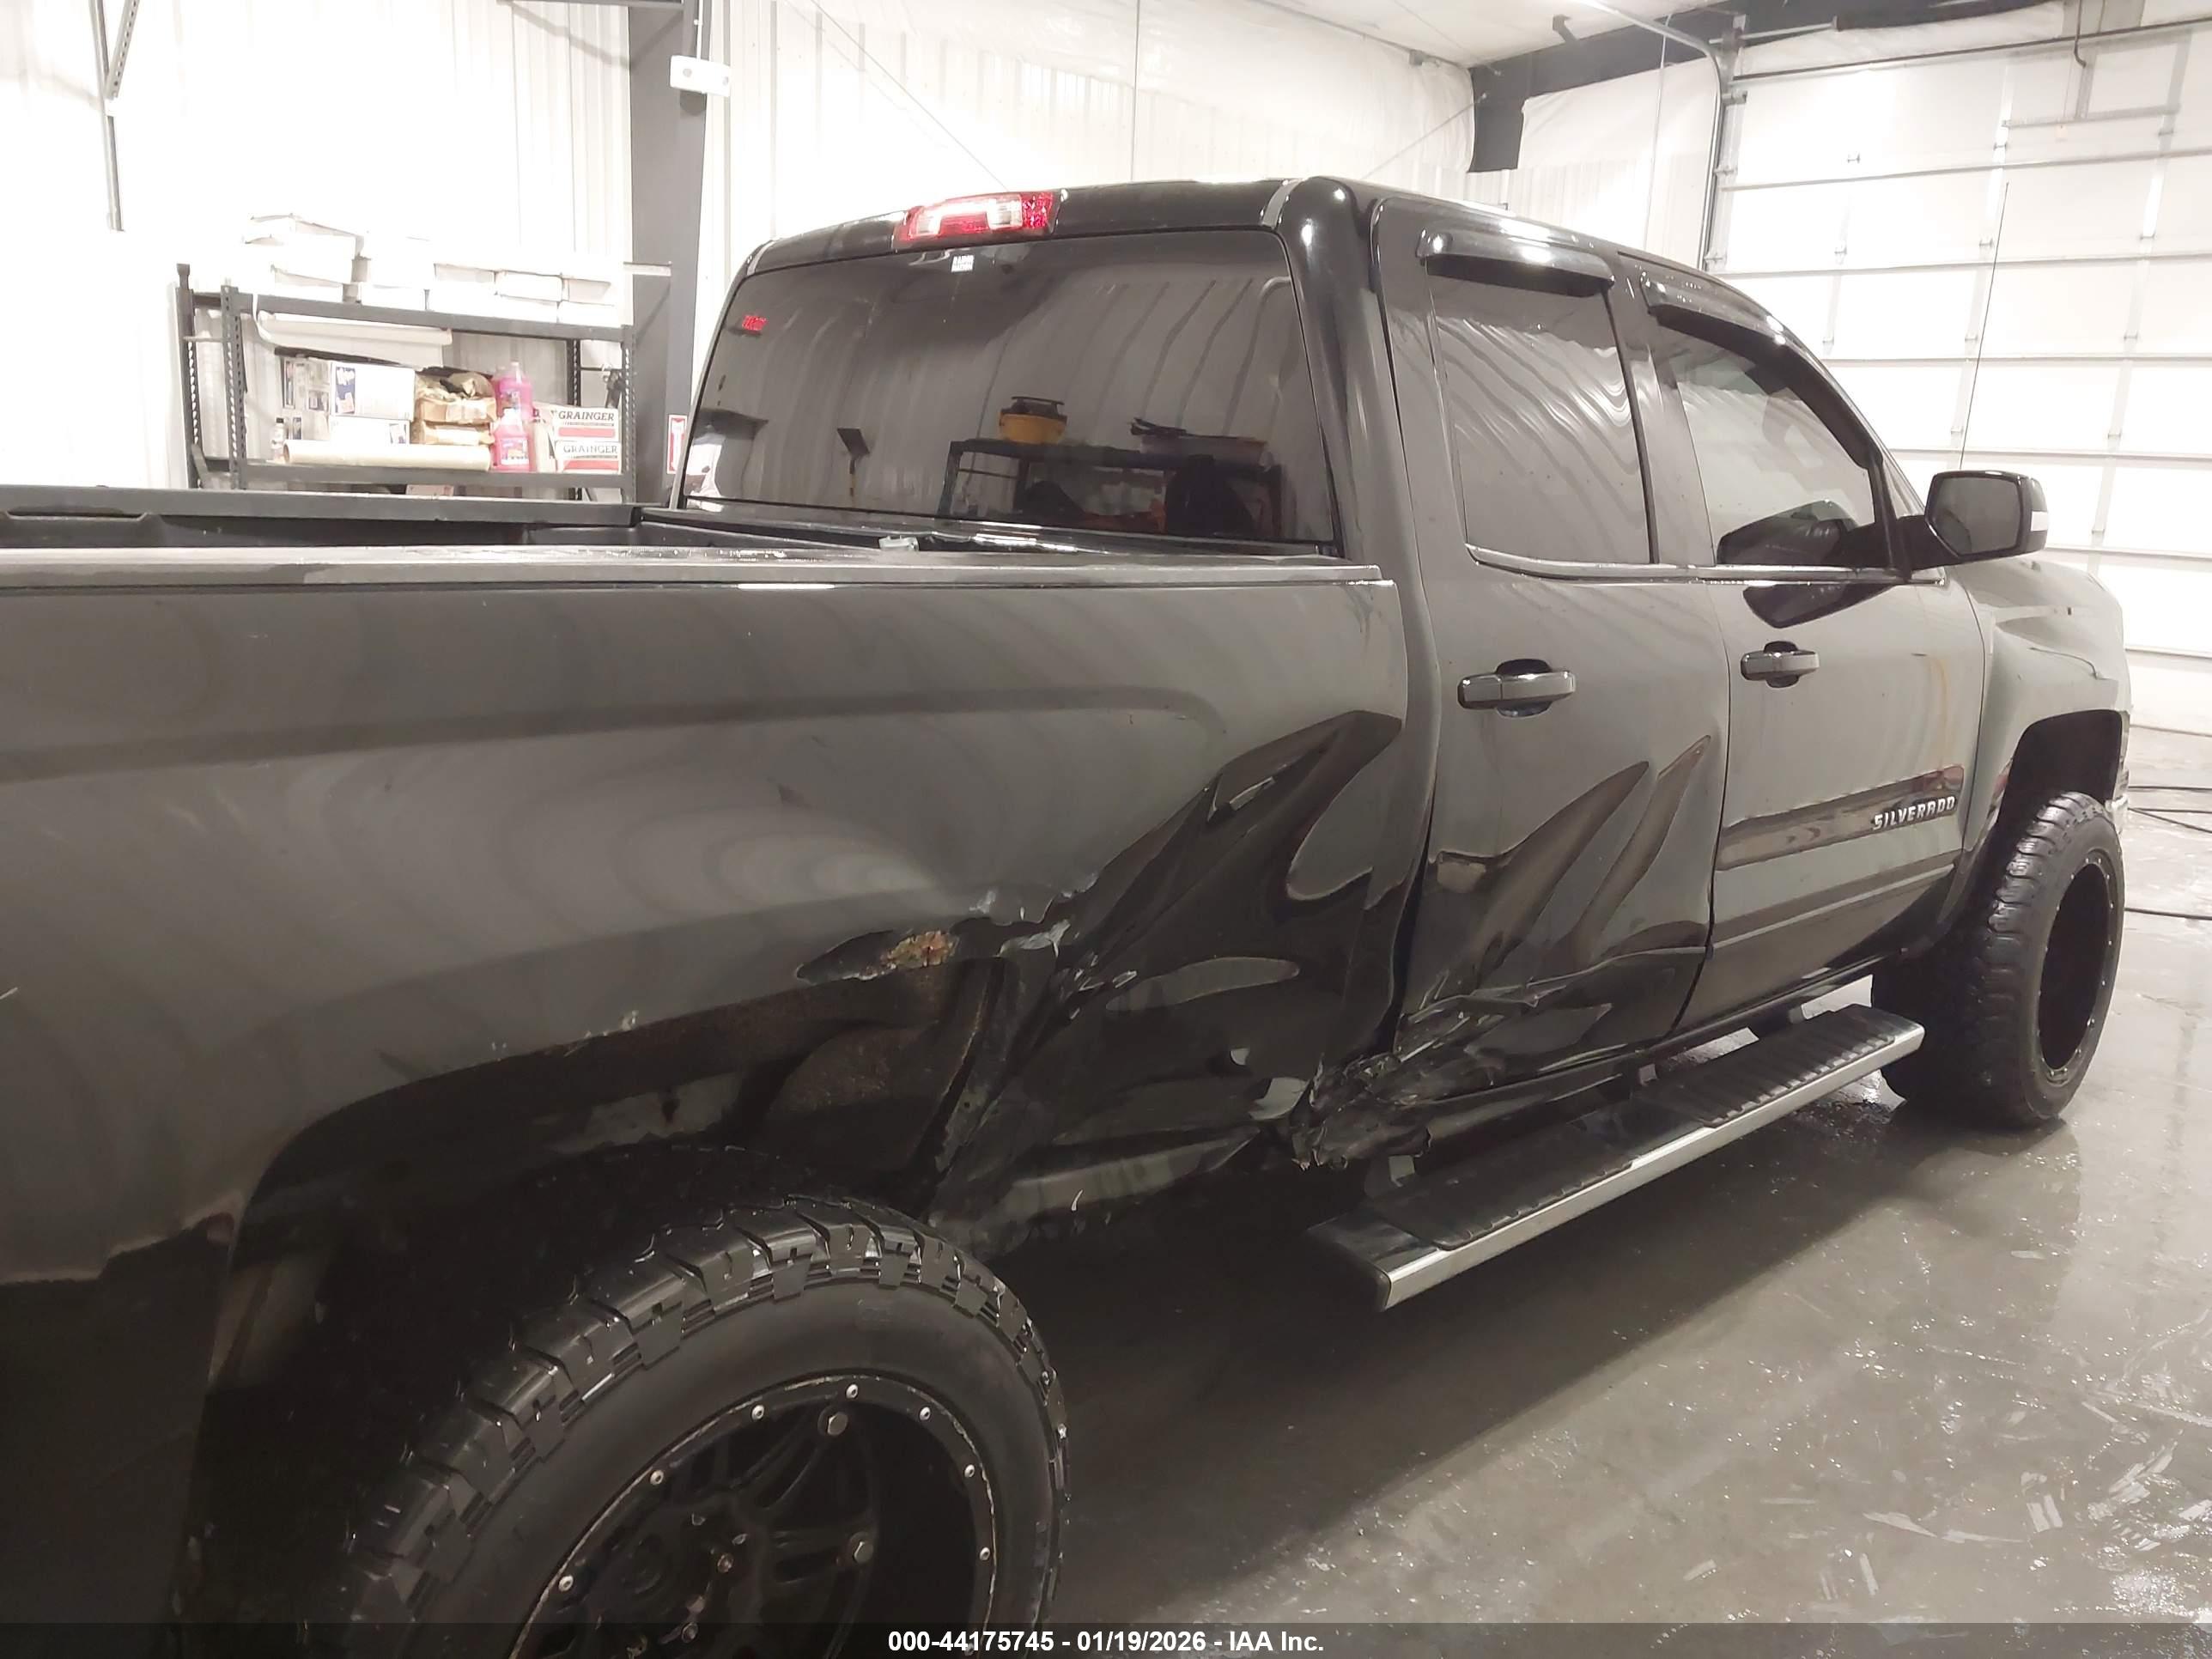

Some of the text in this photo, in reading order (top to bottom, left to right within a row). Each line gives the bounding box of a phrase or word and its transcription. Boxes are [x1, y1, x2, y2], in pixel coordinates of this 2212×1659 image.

[558, 410, 615, 421] GRAINGER
[563, 445, 618, 454] GRAINGER
[1873, 796, 1956, 830] SILVERADO
